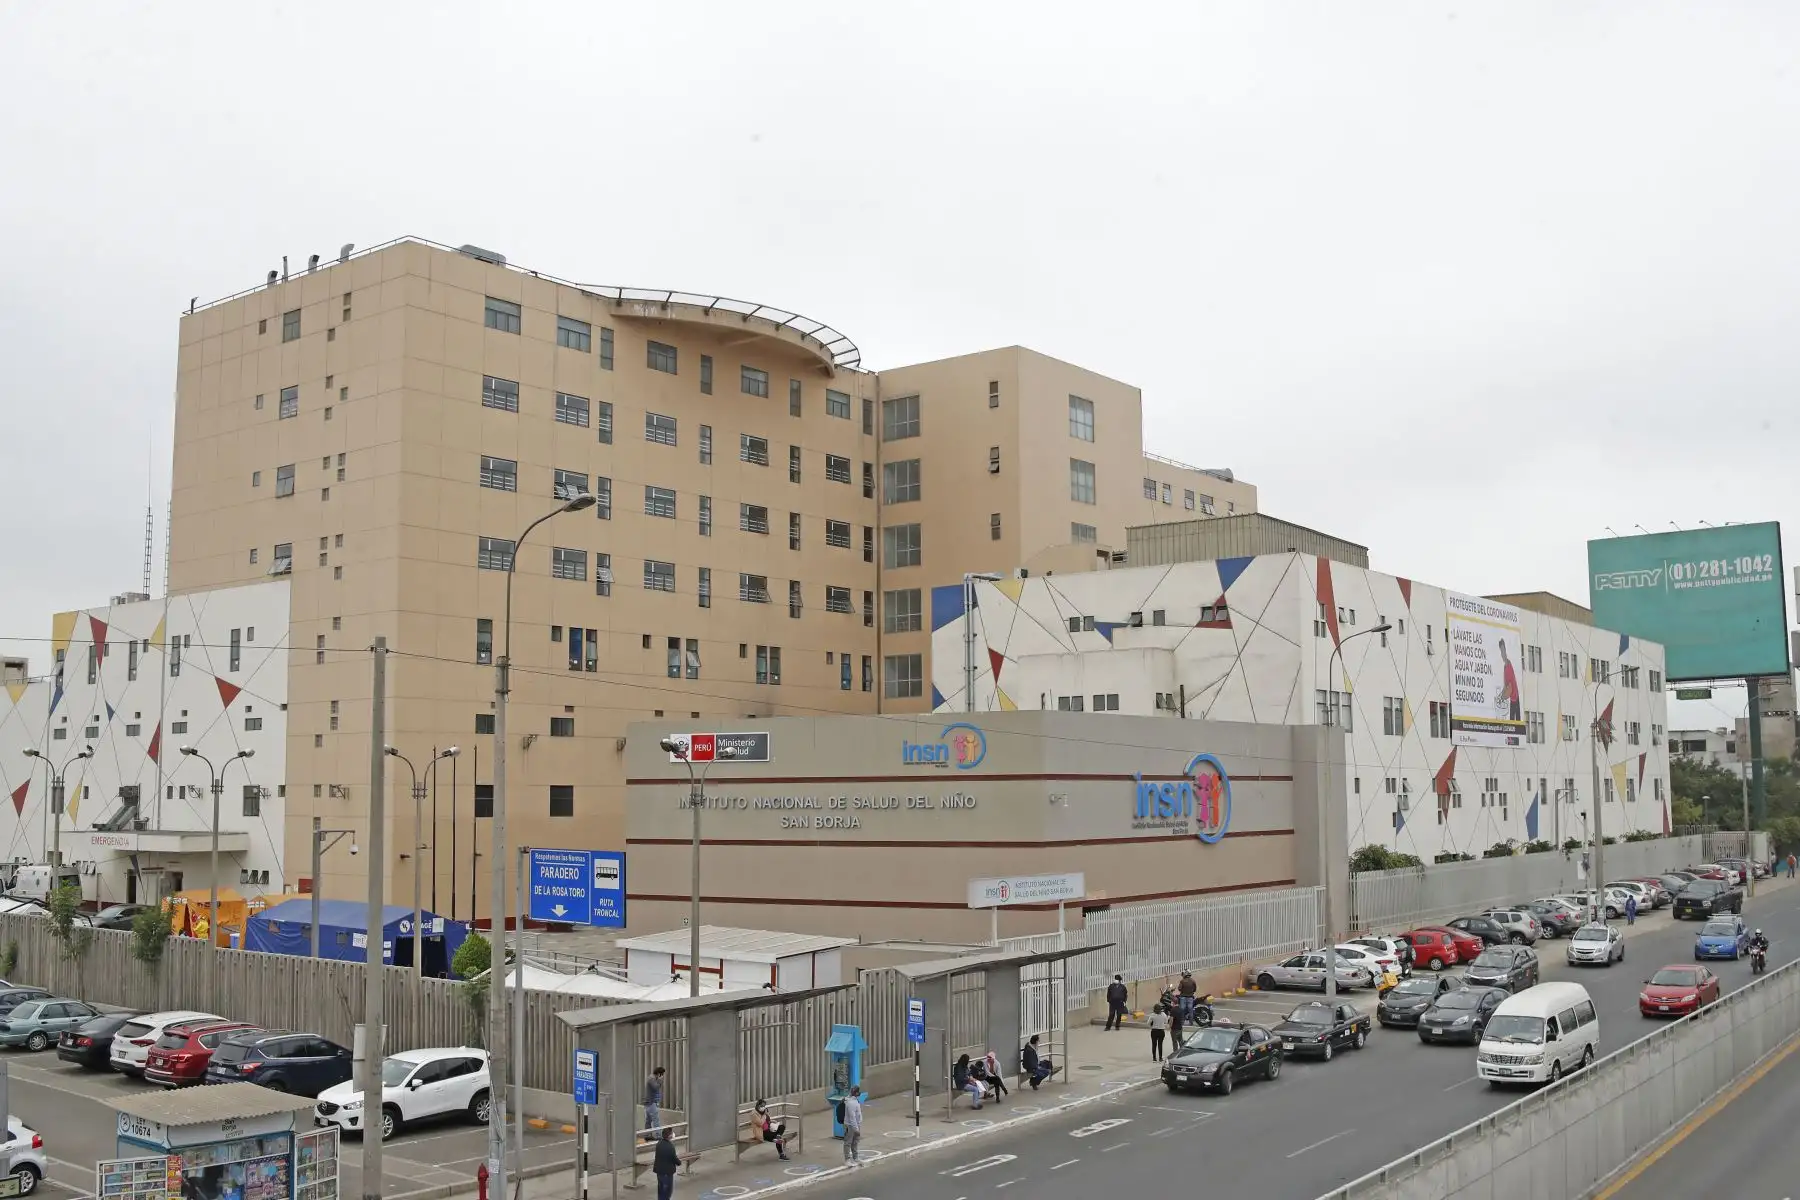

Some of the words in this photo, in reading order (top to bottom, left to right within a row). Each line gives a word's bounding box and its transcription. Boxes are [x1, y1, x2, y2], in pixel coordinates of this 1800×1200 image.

[1669, 562, 1697, 580] (01)
[1700, 554, 1773, 577] 281-1042
[1595, 568, 1662, 590] PETTY
[1477, 603, 1487, 615] DEL
[1473, 632, 1483, 644] LAS
[1454, 644, 1474, 658] MANOS
[1474, 648, 1486, 660] CON
[1455, 659, 1469, 671] AGUA
[1476, 677, 1484, 689] 20
[1455, 689, 1485, 704] SEGUNDOS
[694, 743, 712, 752] PERÚ
[718, 738, 755, 747] Ministerio
[902, 739, 950, 762] insn
[1134, 771, 1192, 817] insn
[752, 795, 822, 809] NACIONAL
[828, 796, 847, 808] DE
[852, 795, 900, 808] SALUD
[905, 795, 934, 808] DEL
[940, 793, 976, 808] NIÑO
[780, 816, 809, 828] SAN
[814, 816, 861, 828] BORJA
[91, 836, 129, 847] EMERGENCIA
[540, 866, 579, 880] PARADERO
[534, 885, 542, 895] DE
[543, 886, 551, 895] LA
[552, 886, 567, 896] ROSA
[569, 887, 585, 898] TORO
[599, 898, 614, 907] RUTA
[594, 908, 620, 918] TRONCAL
[131, 1124, 151, 1136] 10674
